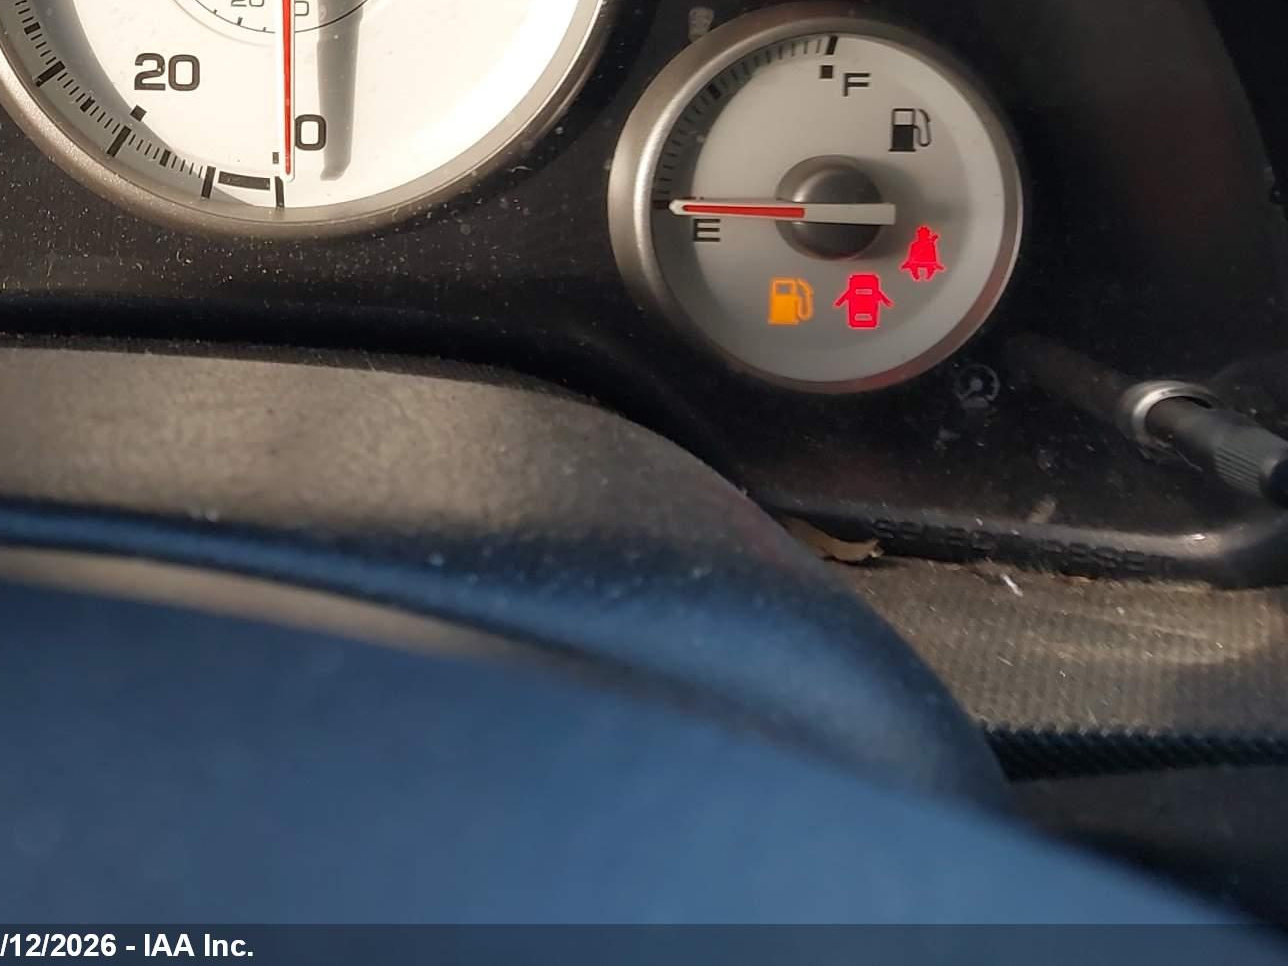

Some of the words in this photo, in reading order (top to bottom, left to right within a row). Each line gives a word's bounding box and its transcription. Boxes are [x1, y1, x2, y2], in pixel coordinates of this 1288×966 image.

[133, 53, 201, 92] 20
[843, 72, 871, 96] F
[294, 114, 327, 151] 0
[693, 218, 721, 242] E
